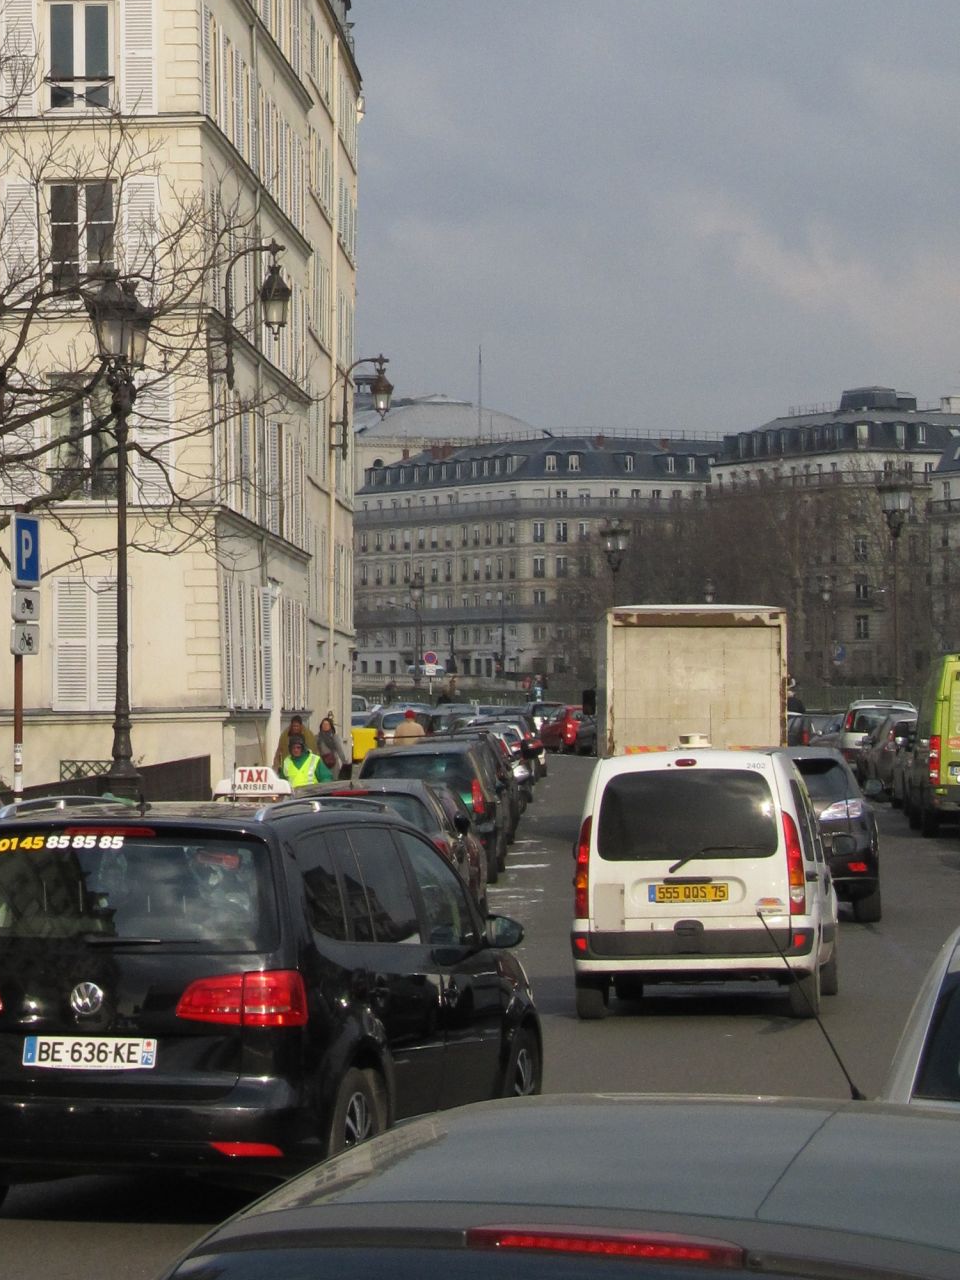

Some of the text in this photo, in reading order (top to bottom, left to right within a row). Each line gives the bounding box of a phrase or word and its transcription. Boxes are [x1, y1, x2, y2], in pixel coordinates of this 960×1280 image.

[21, 529, 33, 570] P
[238, 769, 268, 783] TAXI
[231, 783, 274, 791] PARISIEN
[19, 835, 44, 850] 45
[46, 835, 70, 849] 85
[72, 835, 96, 849] 85
[98, 835, 124, 849] 85
[658, 887, 680, 899] 555
[711, 885, 726, 898] 75
[38, 1041, 139, 1063] BE-636-KE
[142, 1052, 153, 1063] 75
